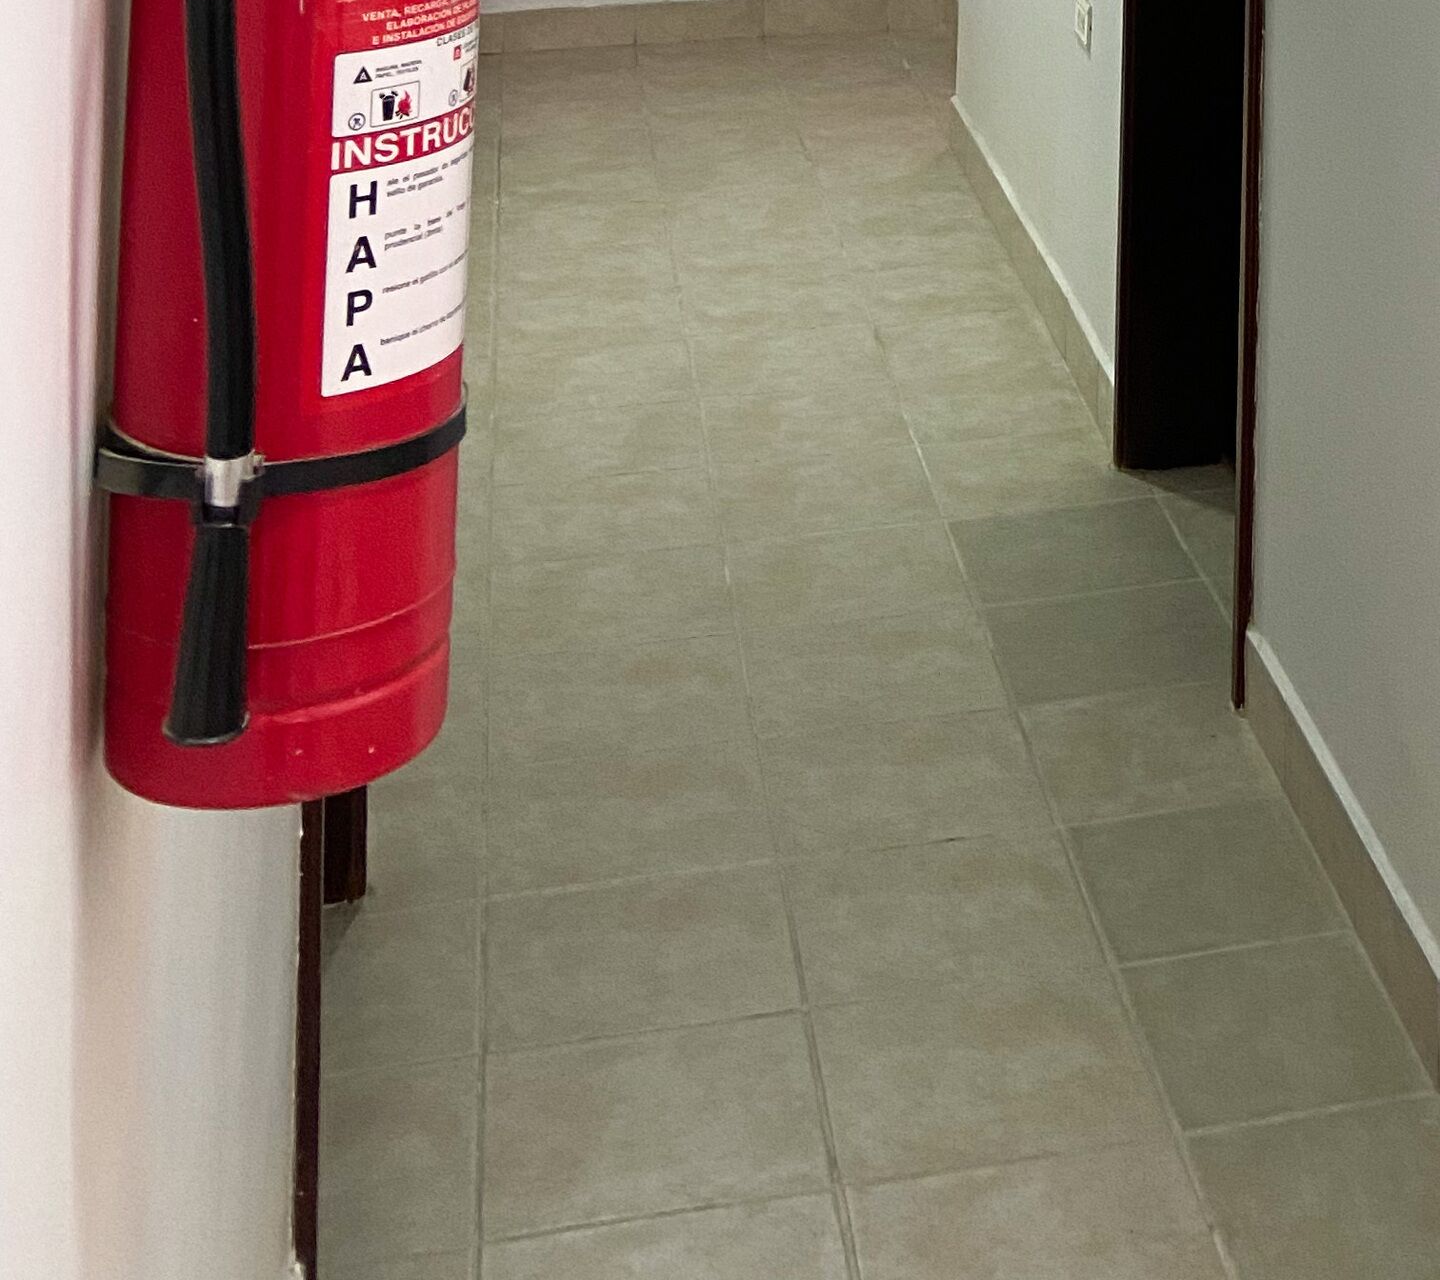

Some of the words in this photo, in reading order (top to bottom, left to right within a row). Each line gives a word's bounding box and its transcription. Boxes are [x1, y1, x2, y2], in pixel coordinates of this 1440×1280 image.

[372, 35, 380, 45] E
[349, 180, 377, 219] H
[345, 236, 377, 274] A
[346, 289, 373, 327] P
[340, 344, 373, 382] A
